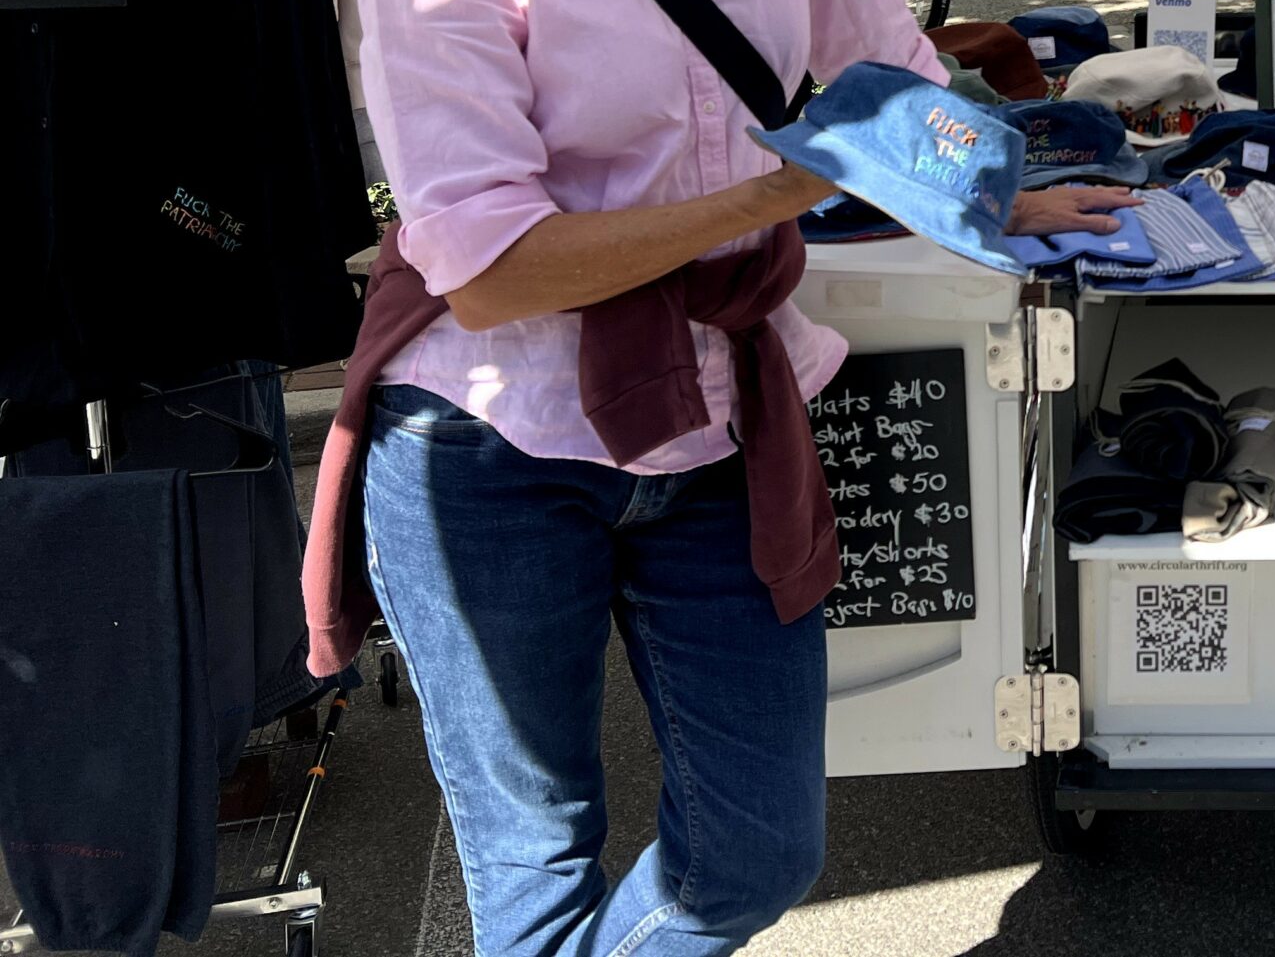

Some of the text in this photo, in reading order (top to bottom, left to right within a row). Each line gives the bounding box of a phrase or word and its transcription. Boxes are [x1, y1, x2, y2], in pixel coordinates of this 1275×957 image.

[926, 107, 979, 148] FUCK
[935, 136, 970, 168] THE
[174, 186, 246, 236] FUCK THE
[886, 378, 946, 409] $40
[844, 446, 878, 470] for
[891, 442, 940, 462] $20
[889, 471, 947, 494] $50
[913, 501, 969, 528] $30
[850, 570, 886, 590] for
[899, 562, 949, 586] $25
[1117, 559, 1248, 572] www.circularthrift.org
